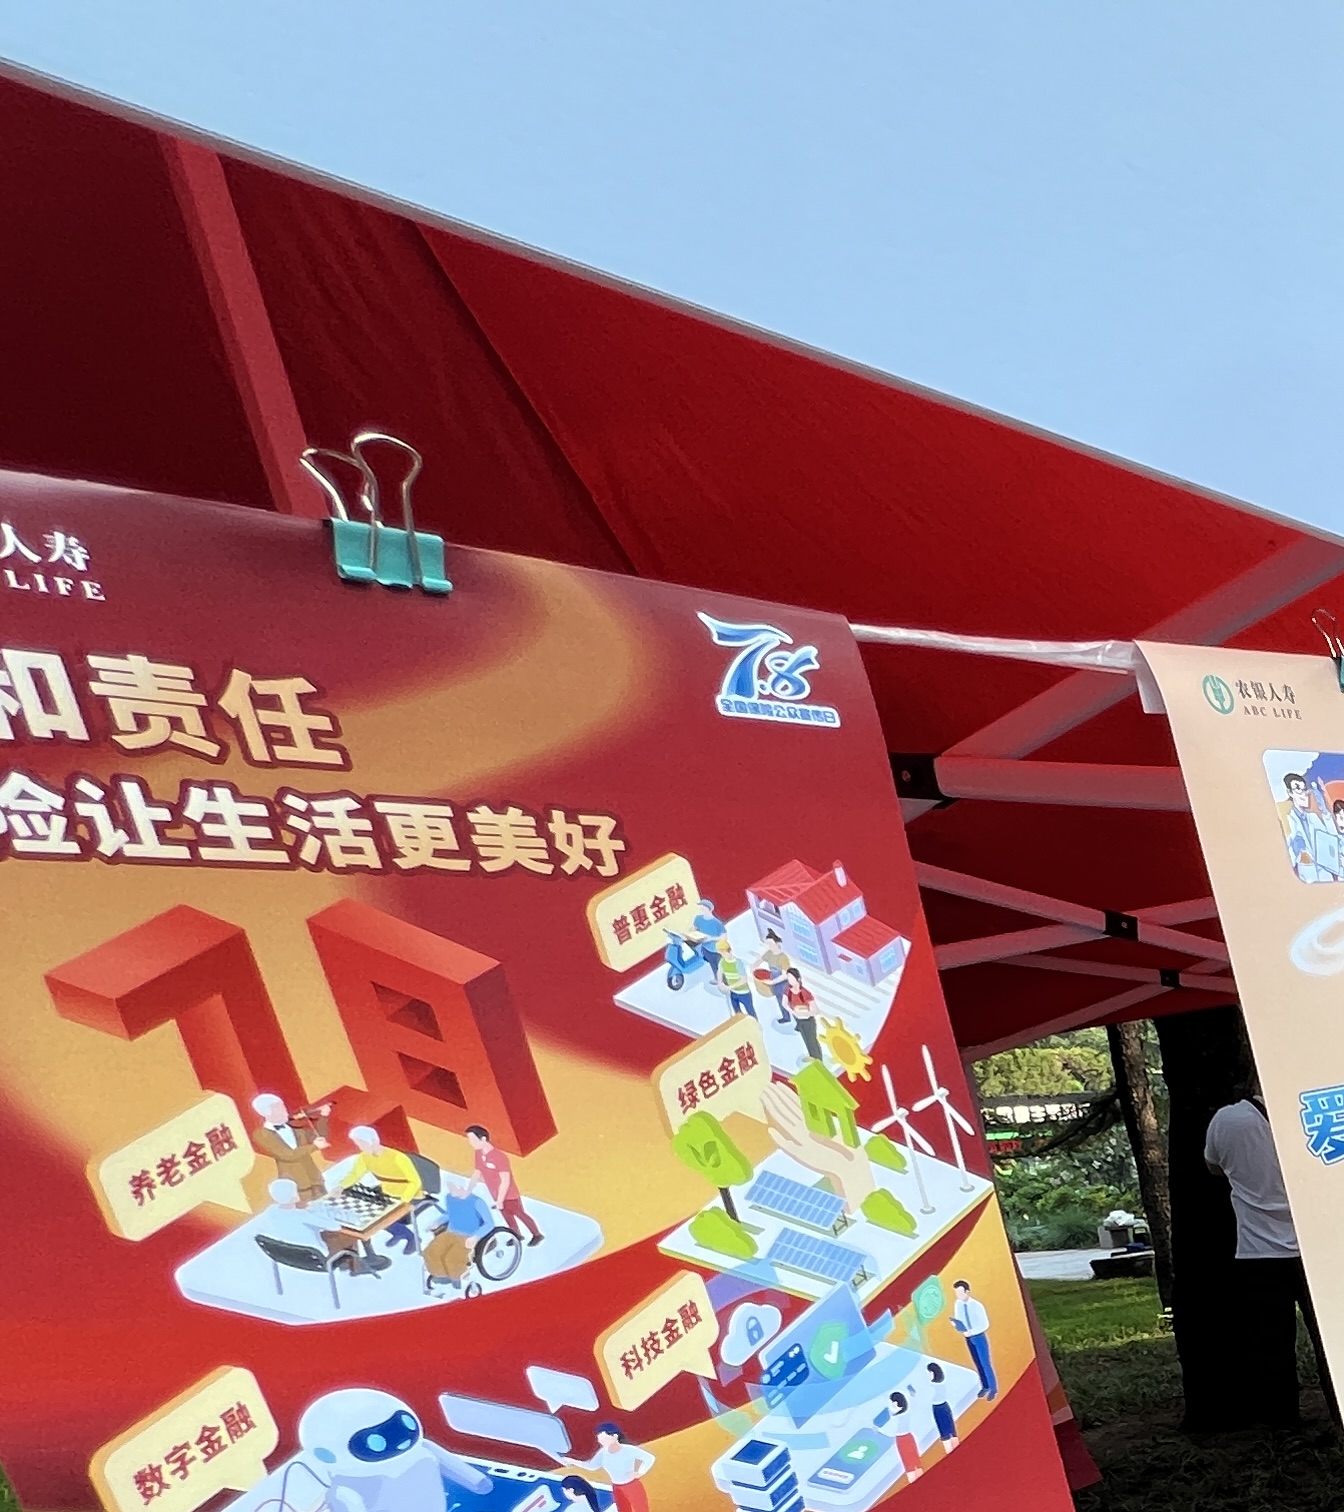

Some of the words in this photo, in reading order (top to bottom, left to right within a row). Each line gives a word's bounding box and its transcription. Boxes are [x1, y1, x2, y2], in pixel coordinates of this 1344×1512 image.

[8, 572, 107, 602] LIFE
[0, 648, 350, 770] 和责任
[1235, 679, 1296, 705] 农银人寿
[1243, 705, 1267, 717] ABC
[1272, 707, 1302, 720] LIFE
[0, 772, 627, 878] 险让生活更美好
[610, 881, 690, 946] 普惠金融
[674, 1041, 760, 1113] 绿色金融
[127, 1122, 239, 1206] 养老金融
[618, 1297, 707, 1384] 科技金融
[130, 1400, 260, 1504] 数字金融
